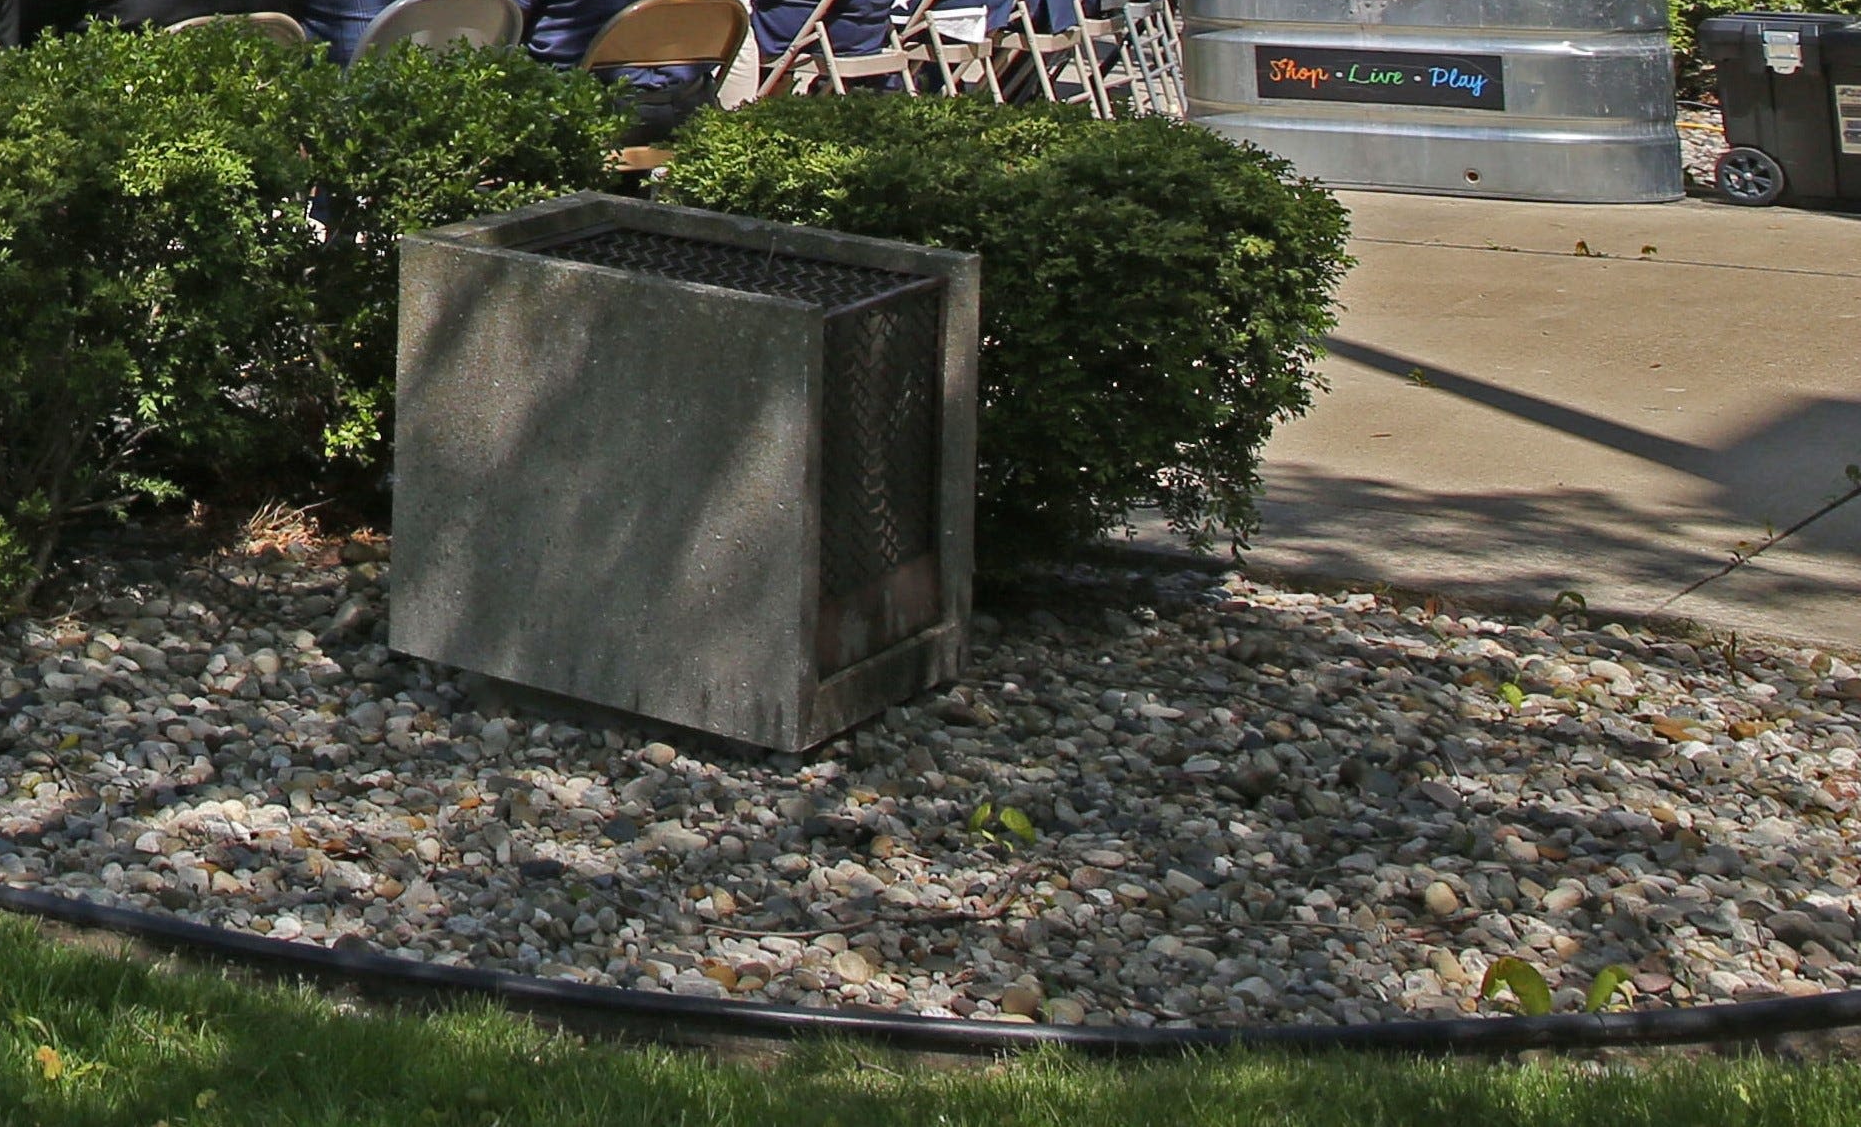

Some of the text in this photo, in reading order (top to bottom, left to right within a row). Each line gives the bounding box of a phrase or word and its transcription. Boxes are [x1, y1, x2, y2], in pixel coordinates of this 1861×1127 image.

[1269, 57, 1489, 97] Shop Live Play
